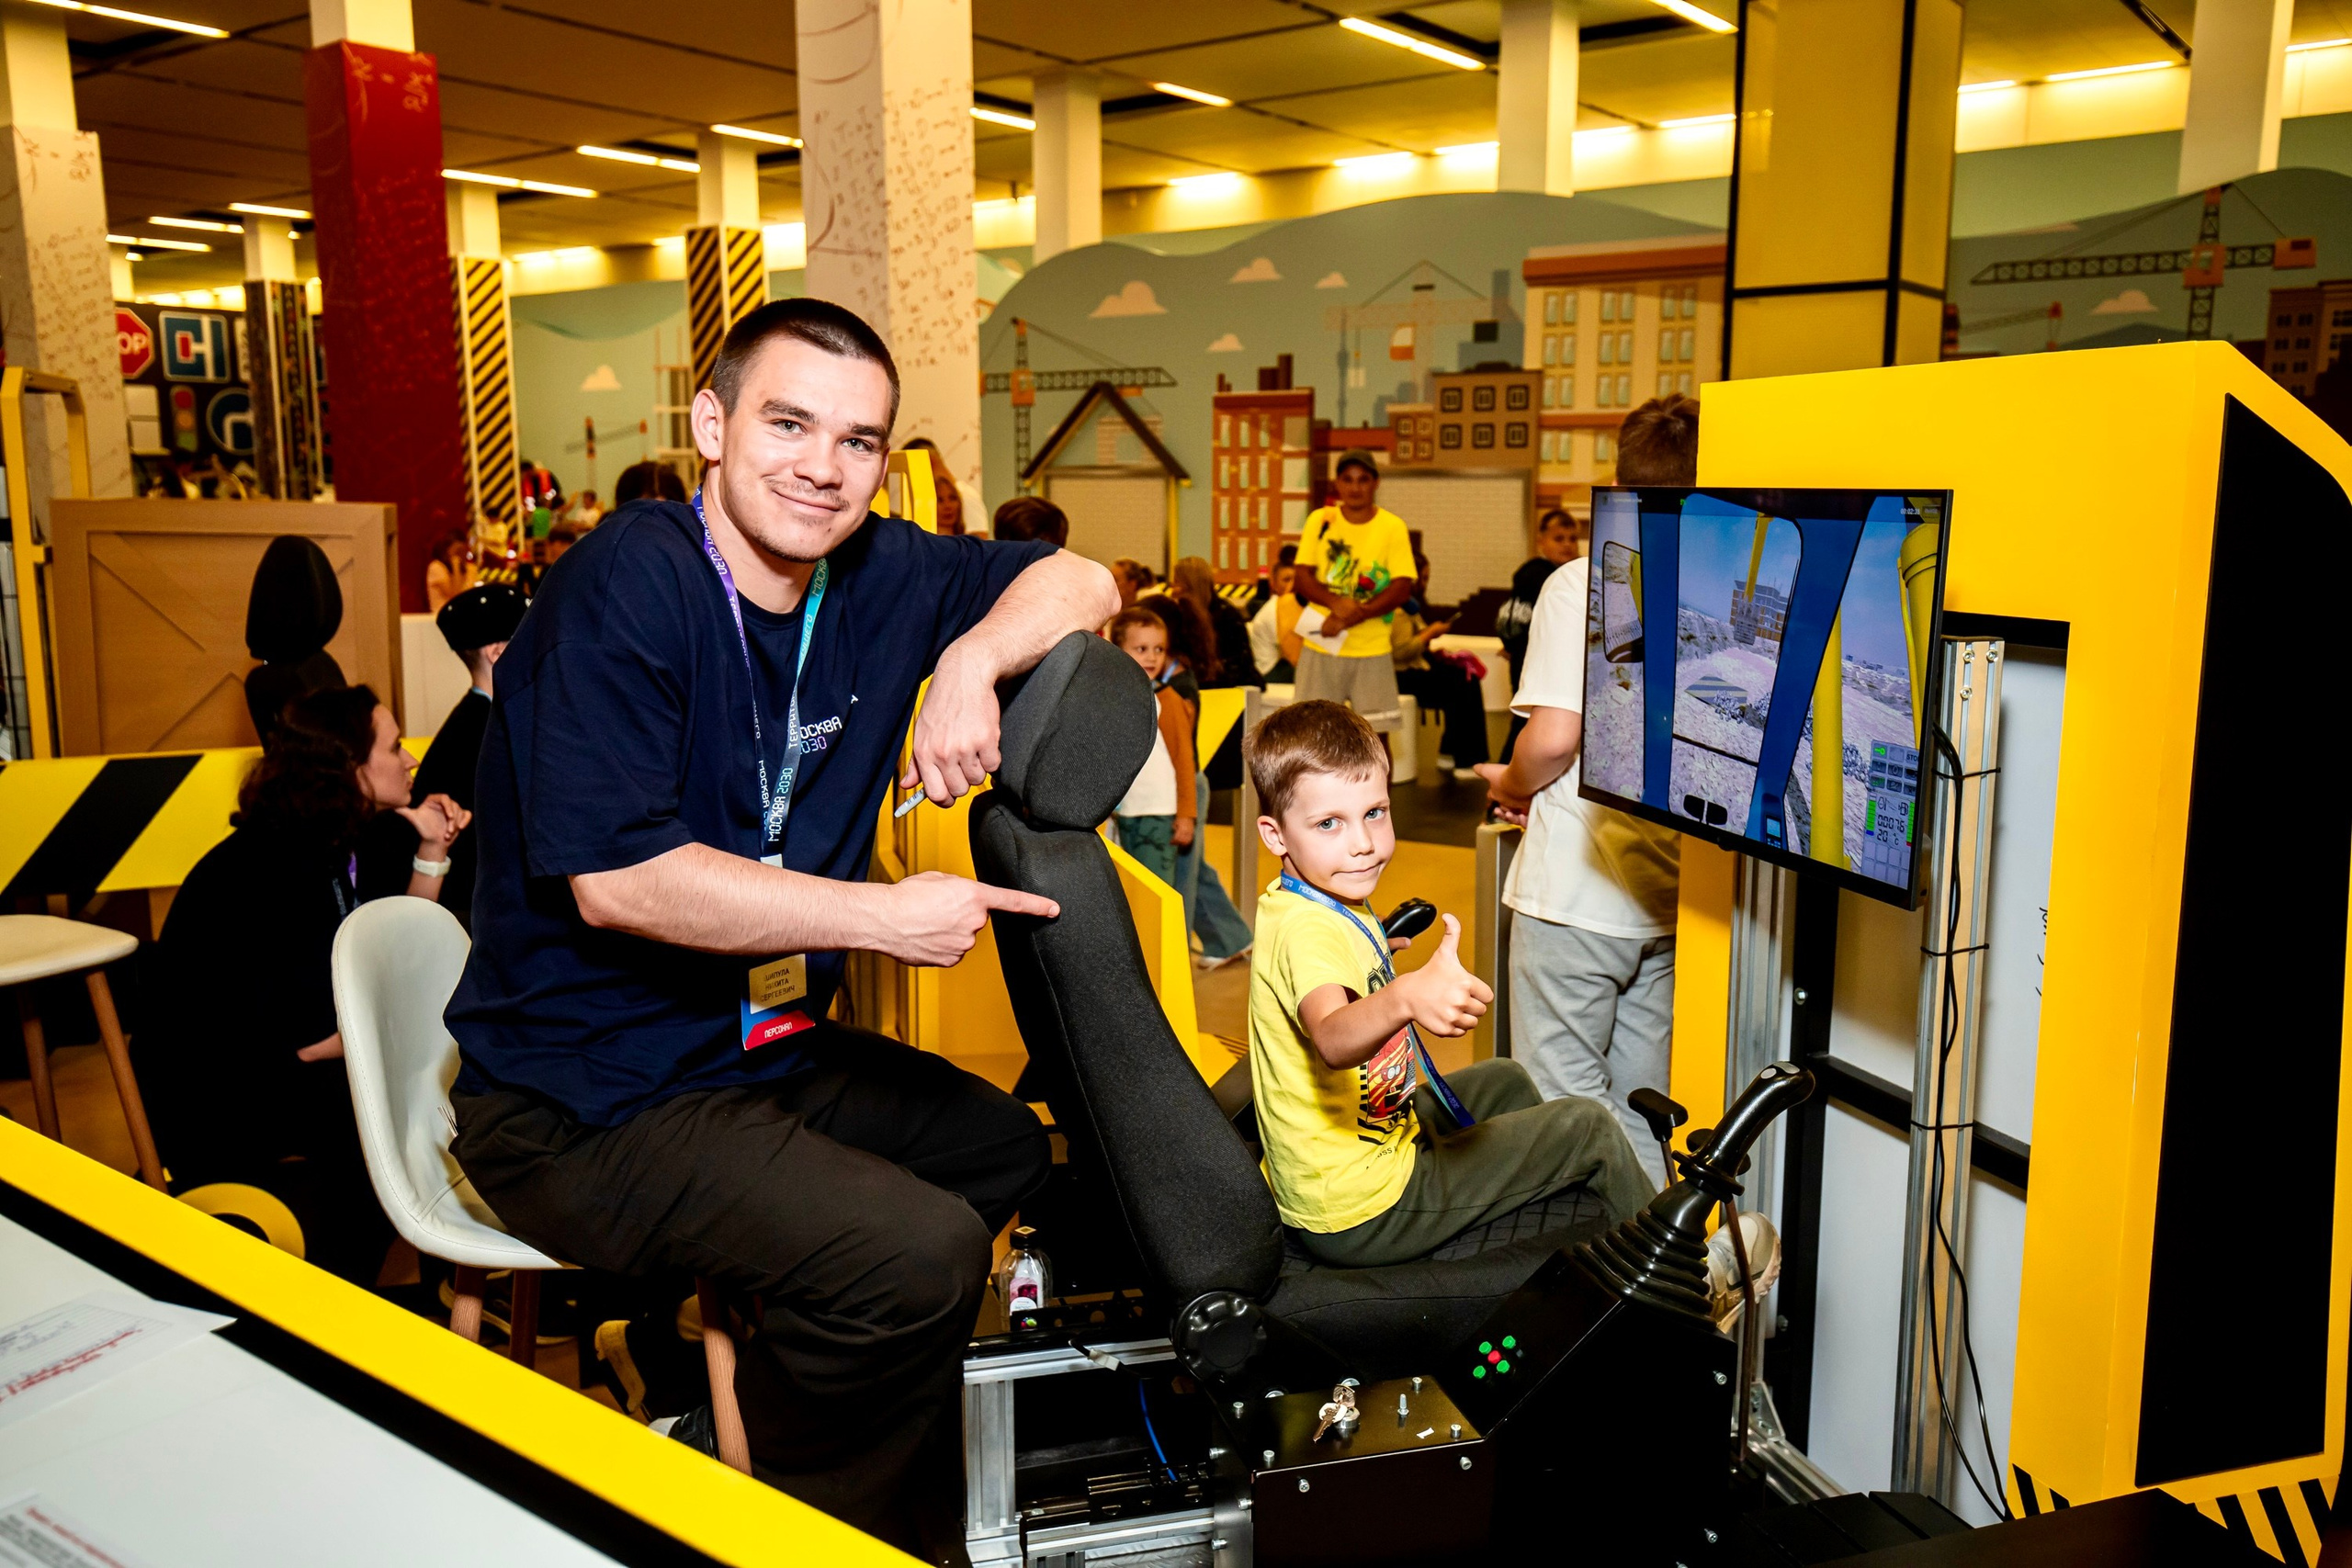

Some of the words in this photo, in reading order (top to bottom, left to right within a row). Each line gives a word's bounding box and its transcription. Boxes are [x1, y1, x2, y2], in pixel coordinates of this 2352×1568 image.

[118, 332, 148, 355] OP
[812, 558, 827, 597] МОСКВ
[787, 690, 798, 750] ТЕРРИТО
[799, 716, 842, 739] ОСКВА
[799, 736, 827, 755] 030
[759, 760, 770, 808] МОСКВА
[776, 767, 794, 794] 2030
[768, 796, 786, 842] МОСКВА
[1877, 829, 1888, 842] 20
[760, 985, 796, 1002] СЕРГЕЕВИЧ
[764, 1021, 793, 1039] ПЕРСОНАЛ
